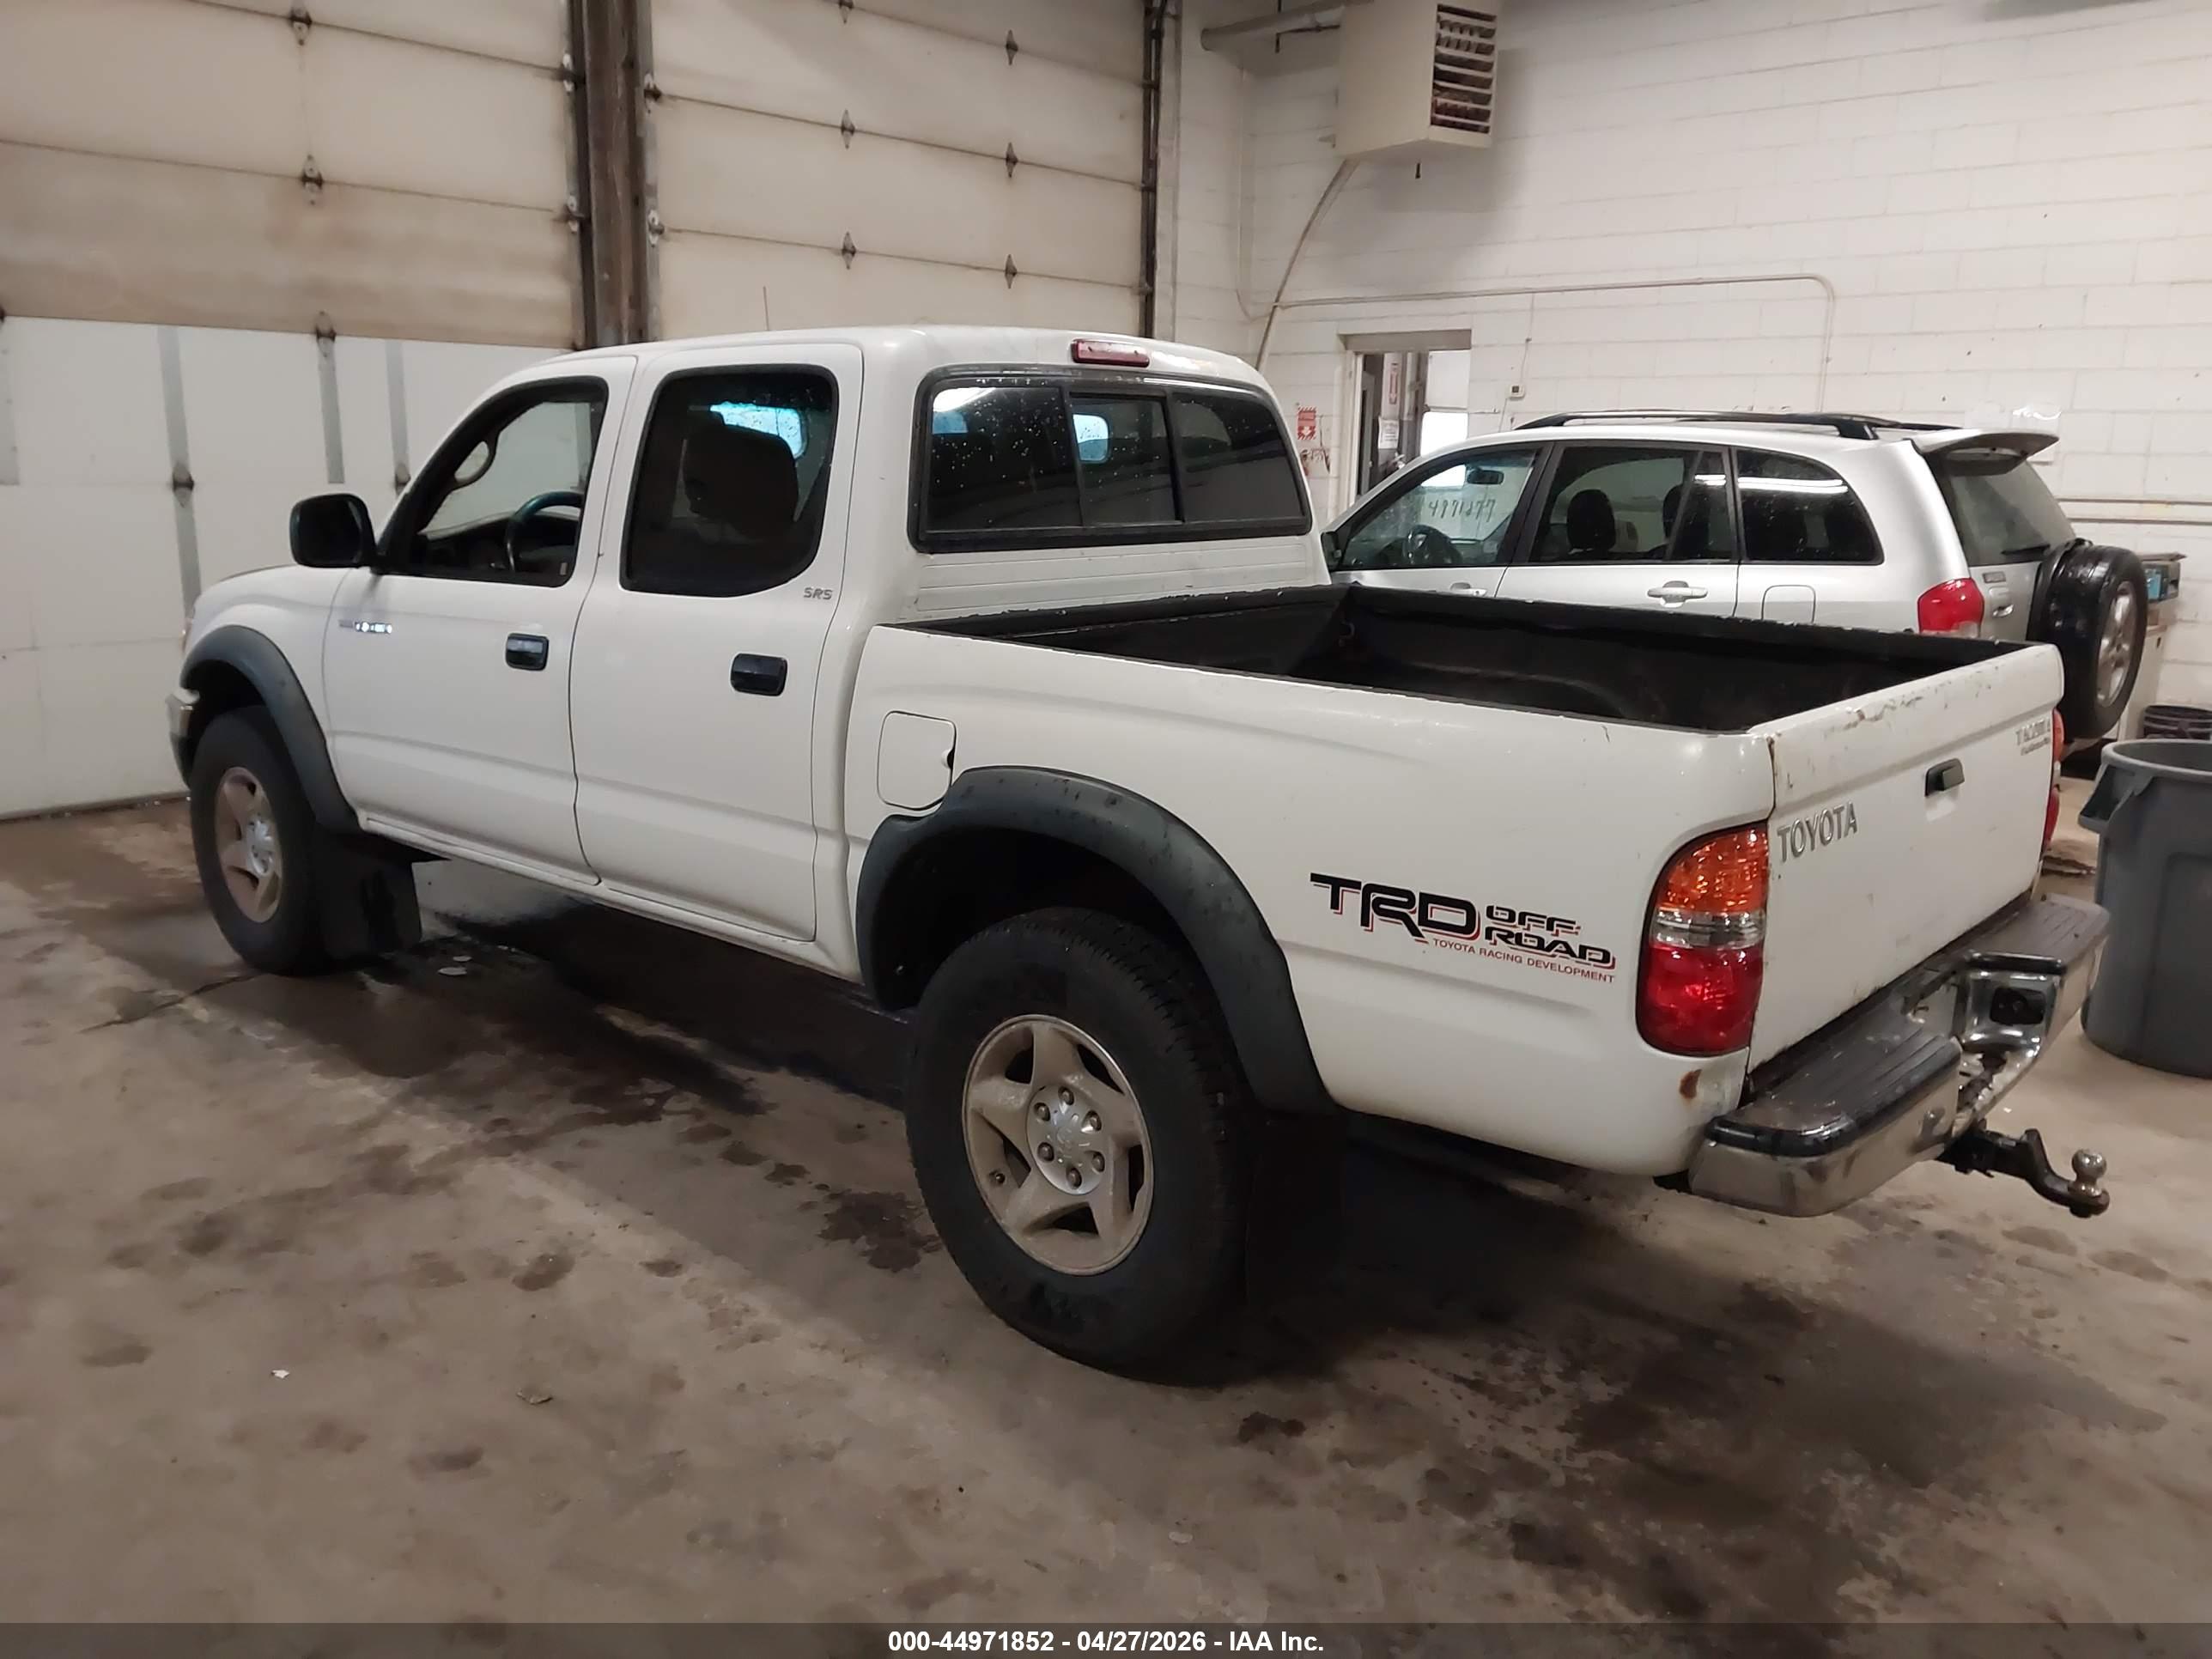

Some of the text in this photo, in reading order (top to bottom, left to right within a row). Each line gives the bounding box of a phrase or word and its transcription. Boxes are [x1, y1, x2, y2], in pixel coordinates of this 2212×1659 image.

[1777, 802, 1857, 863] TOYOTA
[1310, 872, 1481, 943] TRD
[1486, 905, 1581, 937] OFF
[1432, 939, 1614, 983] TOYOTA RACING DEVELOPMENT
[1485, 926, 1616, 969] ROAD
